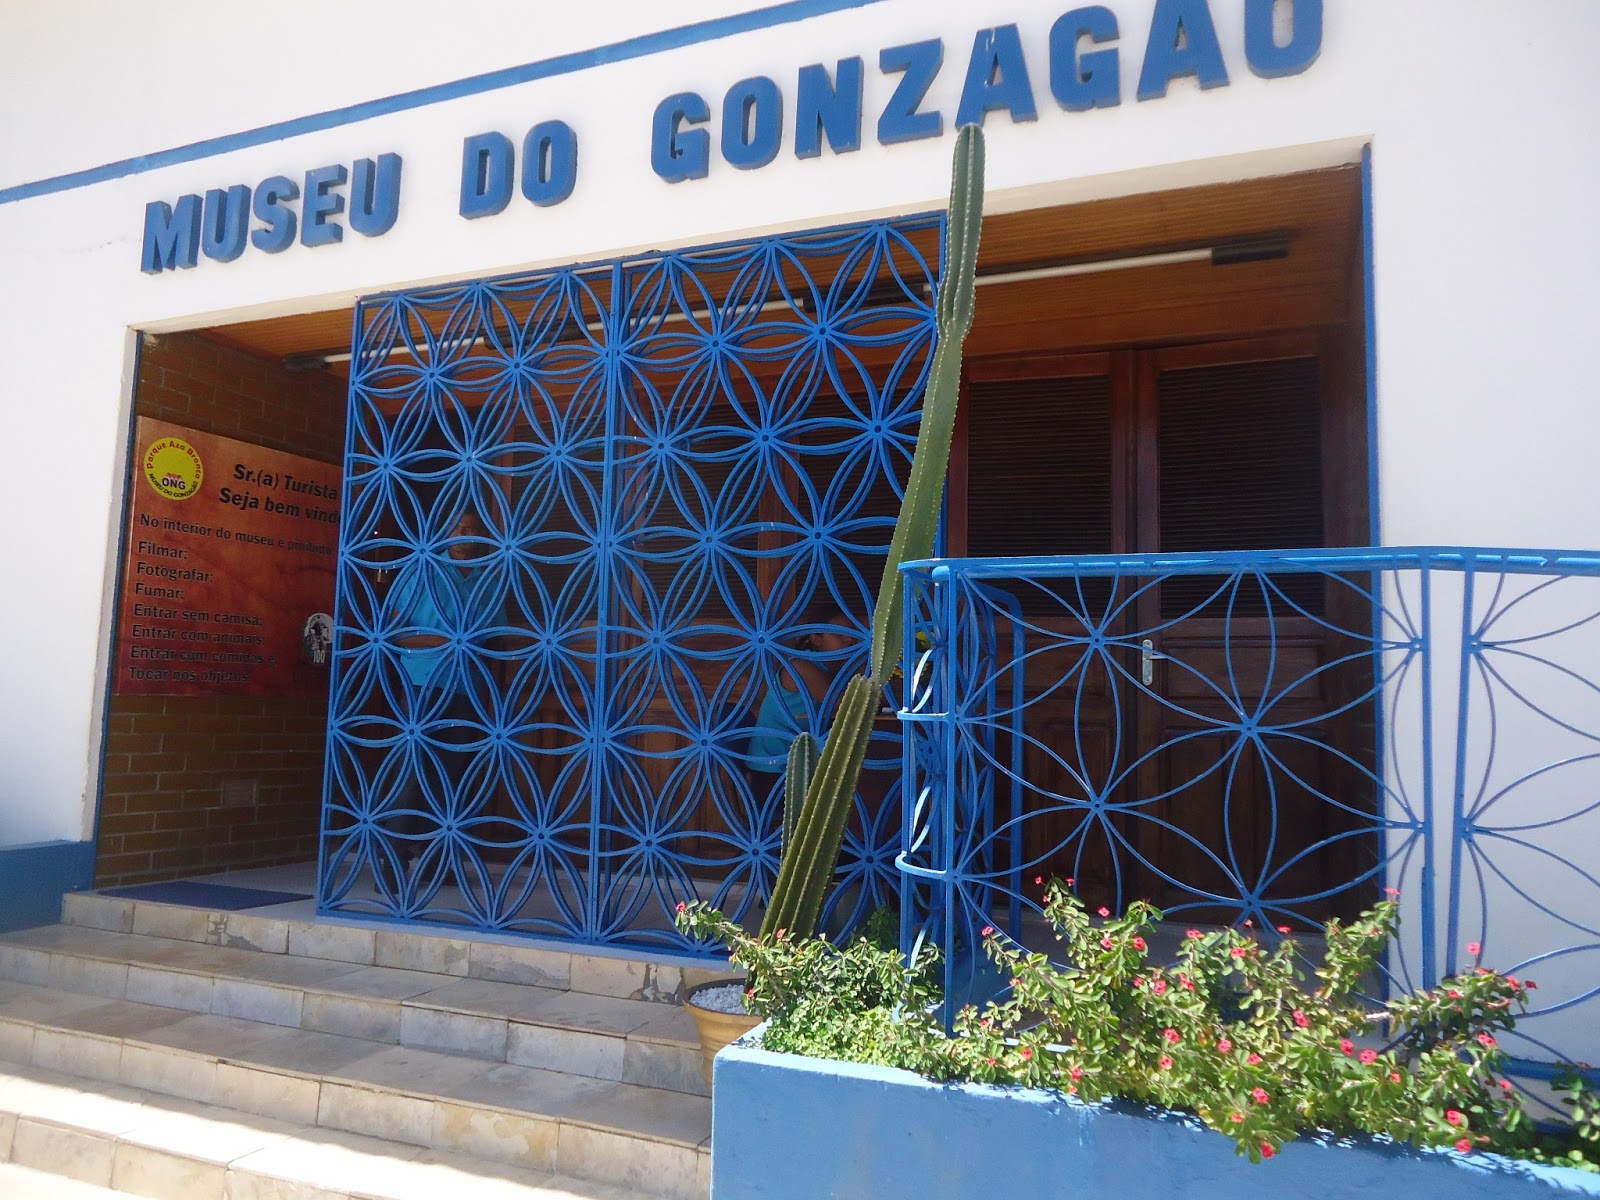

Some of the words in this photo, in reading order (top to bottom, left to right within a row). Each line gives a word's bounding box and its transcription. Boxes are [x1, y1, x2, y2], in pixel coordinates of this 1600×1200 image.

[141, 152, 402, 275] MUSEU
[458, 119, 578, 220] DO
[146, 442, 167, 470] Parque
[169, 440, 186, 451] Aza
[186, 447, 202, 479] Branca
[162, 477, 186, 490] ONG
[233, 463, 279, 490] Sr.(a)
[284, 474, 338, 500] Turista
[218, 487, 260, 511] Seja
[264, 496, 300, 517] bem
[305, 505, 342, 524] vind
[140, 513, 160, 528] No
[163, 517, 212, 537] interior
[215, 527, 231, 540] do
[235, 532, 274, 547] museu
[138, 541, 188, 560] Filmar:
[136, 562, 214, 583] Fotografar:
[135, 583, 185, 600] Fumar:
[133, 604, 178, 620] Entrar
[181, 611, 210, 622] sem
[213, 613, 263, 627] camisa:
[132, 625, 176, 640] Entrar
[180, 629, 209, 641] com
[130, 645, 175, 661] Entrar
[179, 650, 208, 662] com
[211, 652, 264, 665] comidas
[313, 649, 326, 664] 100
[128, 666, 168, 681] Tocar
[172, 669, 197, 682] nos
